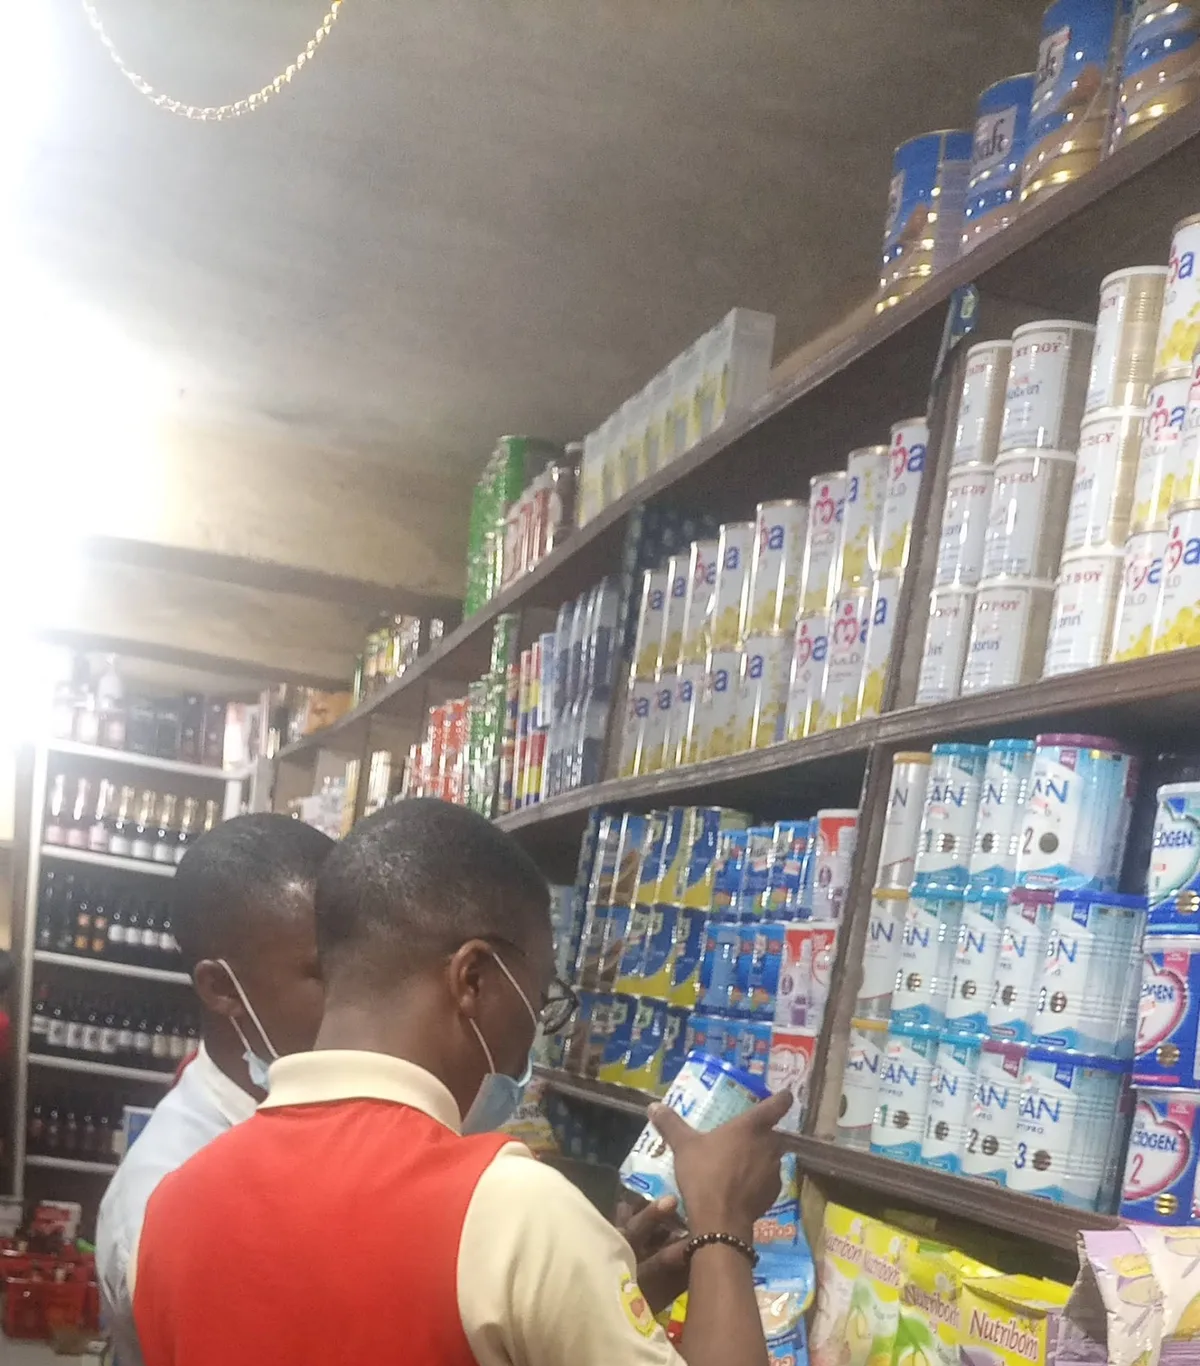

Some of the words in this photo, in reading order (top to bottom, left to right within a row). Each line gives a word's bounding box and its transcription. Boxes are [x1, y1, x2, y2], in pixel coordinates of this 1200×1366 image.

[1013, 1141, 1027, 1169] 3
[1130, 1153, 1144, 1185] 2
[968, 1308, 1039, 1361] Nutribom
